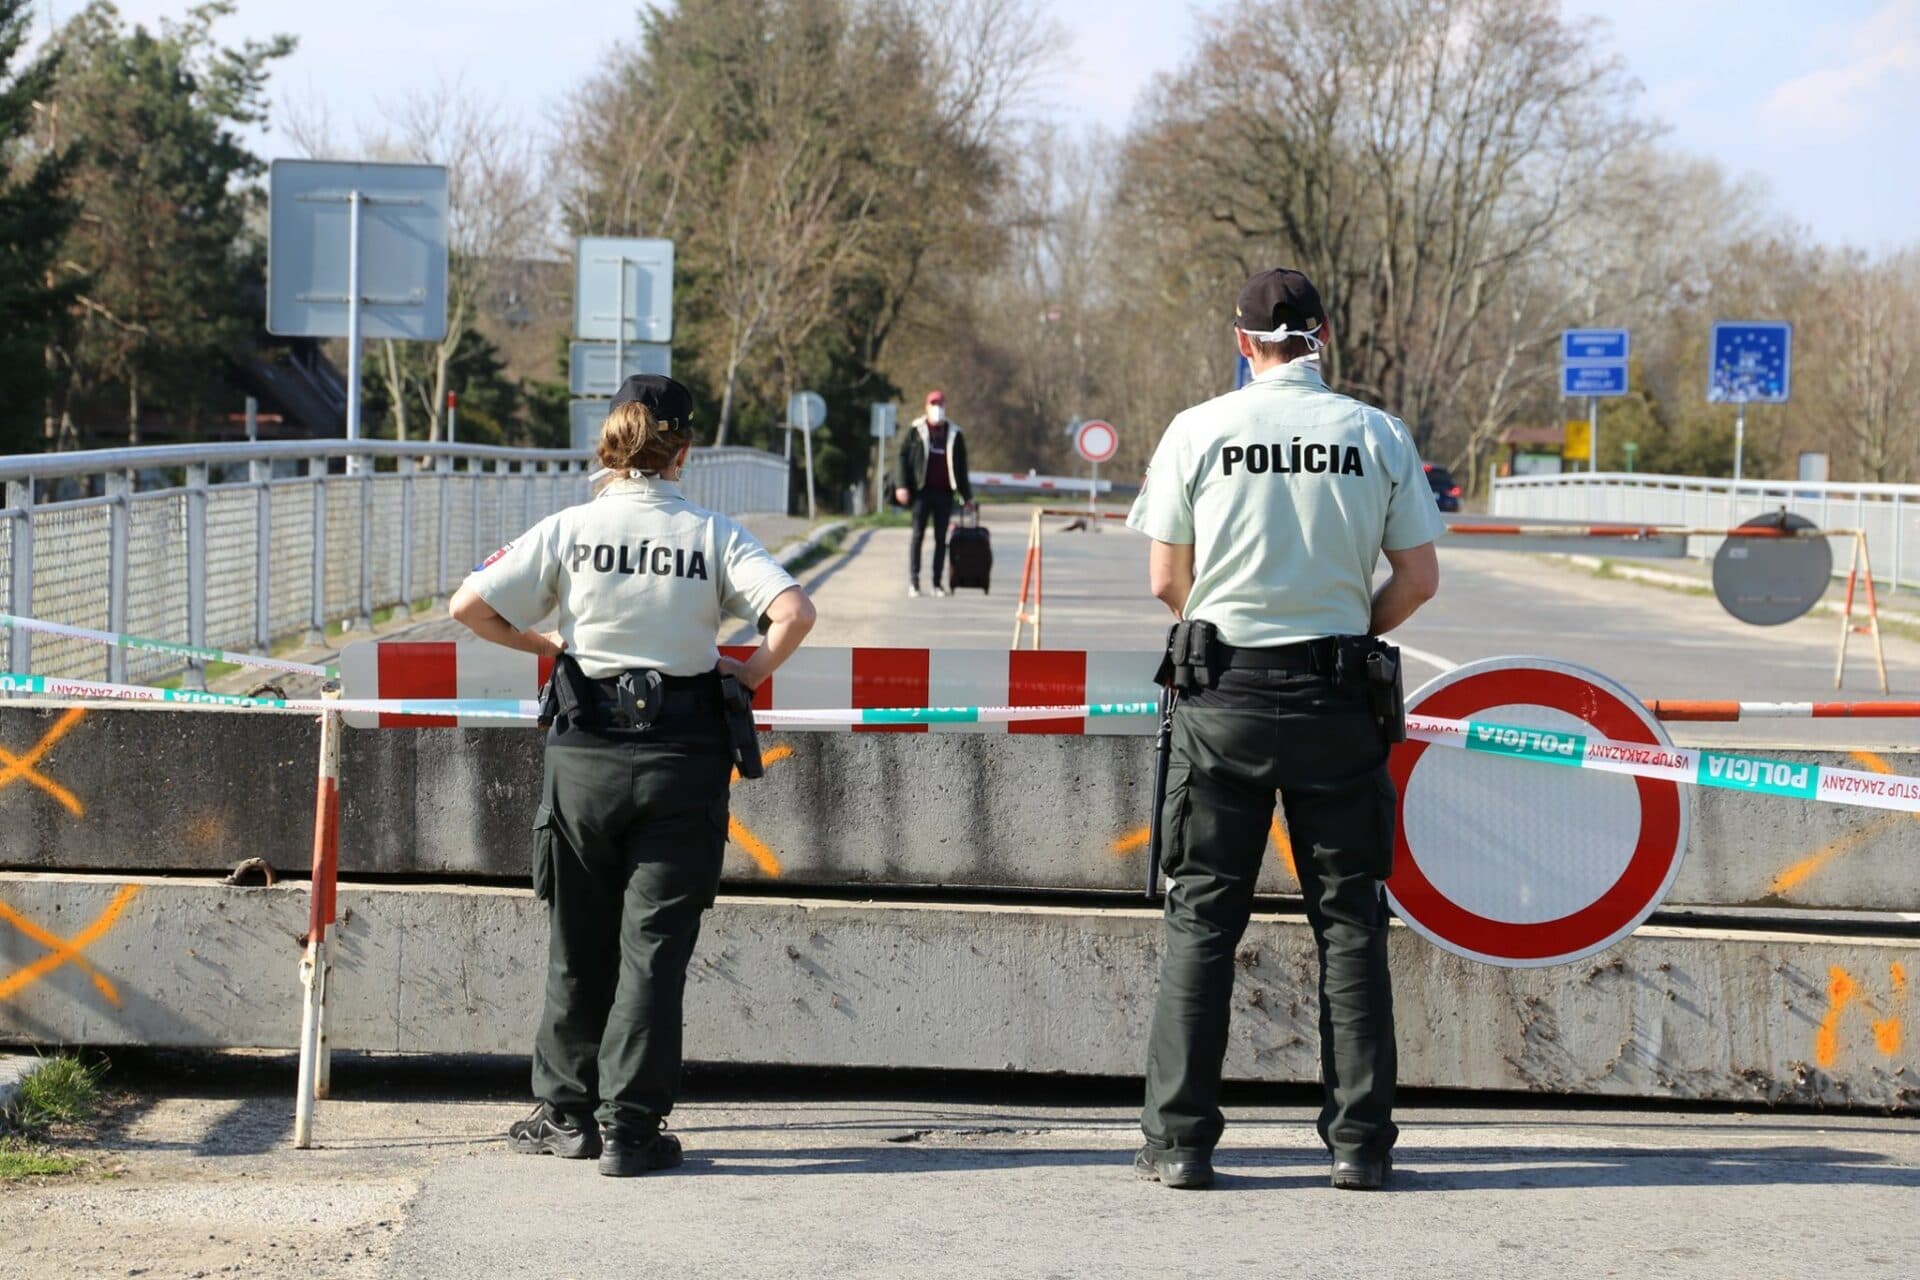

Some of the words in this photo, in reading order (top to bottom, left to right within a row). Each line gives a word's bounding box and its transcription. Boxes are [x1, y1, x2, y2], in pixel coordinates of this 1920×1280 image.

[1222, 436, 1364, 477] POLÍCIA
[572, 540, 708, 580] POLÍCIA
[1476, 725, 1576, 757] POLÍCIA
[1652, 753, 1689, 770] VSTUP
[1708, 755, 1809, 789] POLÍCIA
[1887, 782, 1920, 800] STUP
